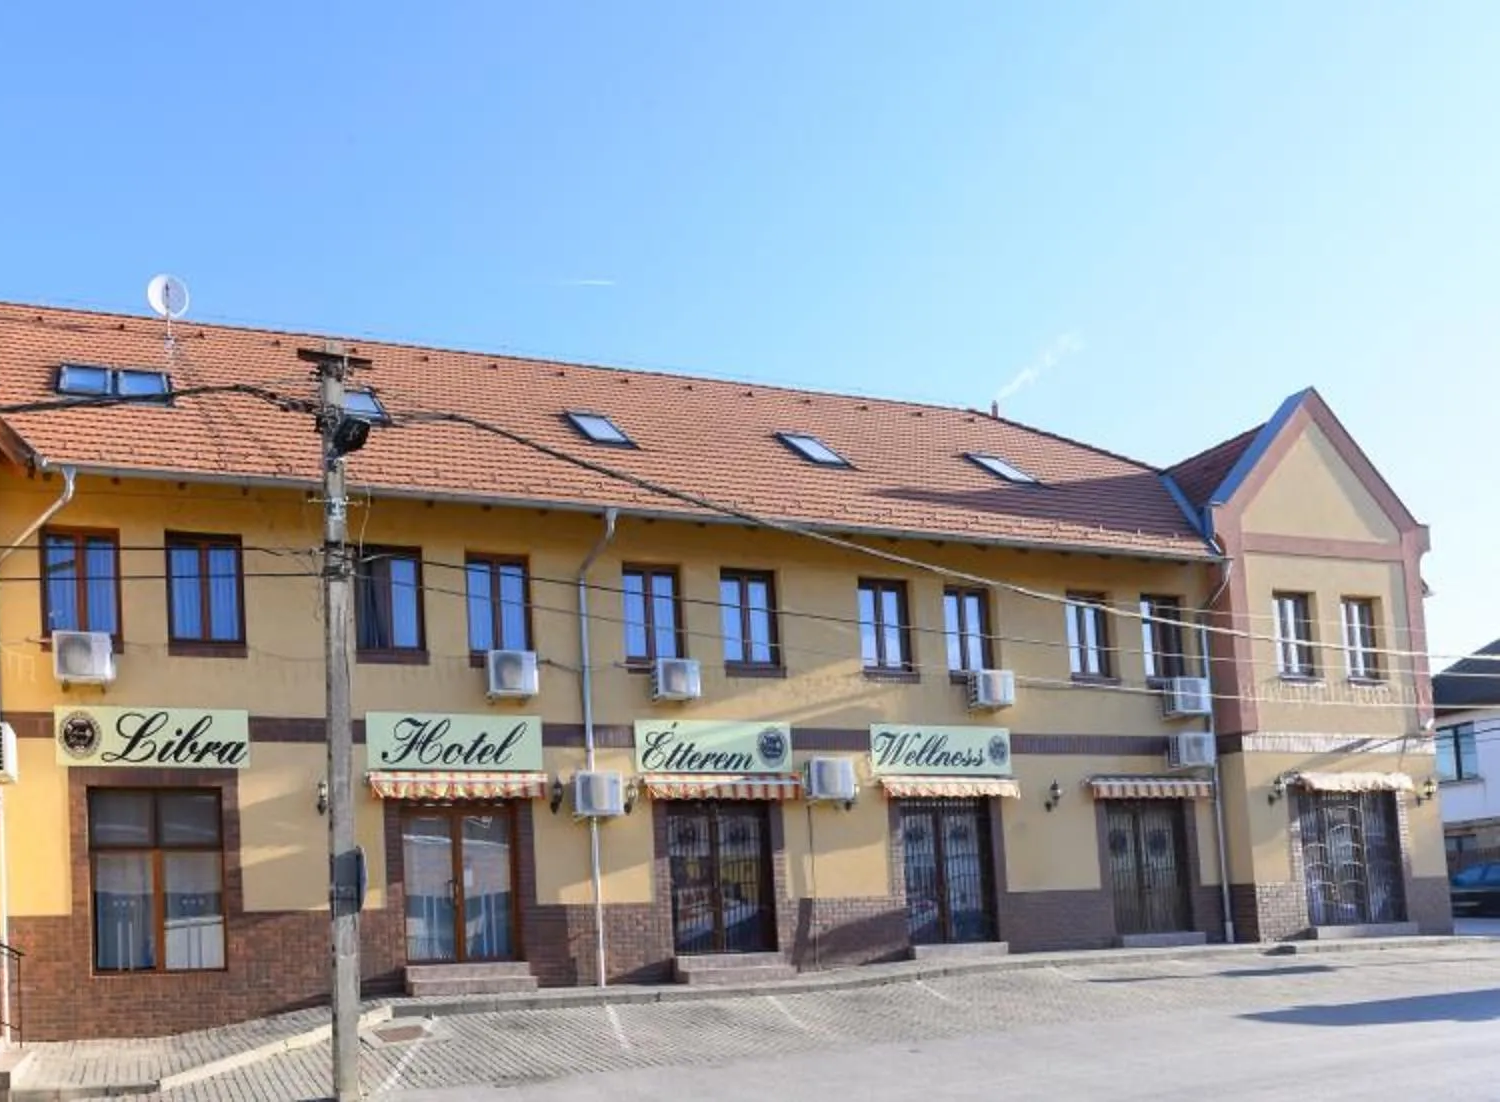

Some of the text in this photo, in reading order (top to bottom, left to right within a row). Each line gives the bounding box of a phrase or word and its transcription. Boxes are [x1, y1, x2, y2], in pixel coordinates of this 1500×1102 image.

[100, 711, 249, 765] Libra
[381, 717, 529, 765] Hotel
[641, 721, 755, 771] Étterem
[873, 731, 986, 767] Wellness
